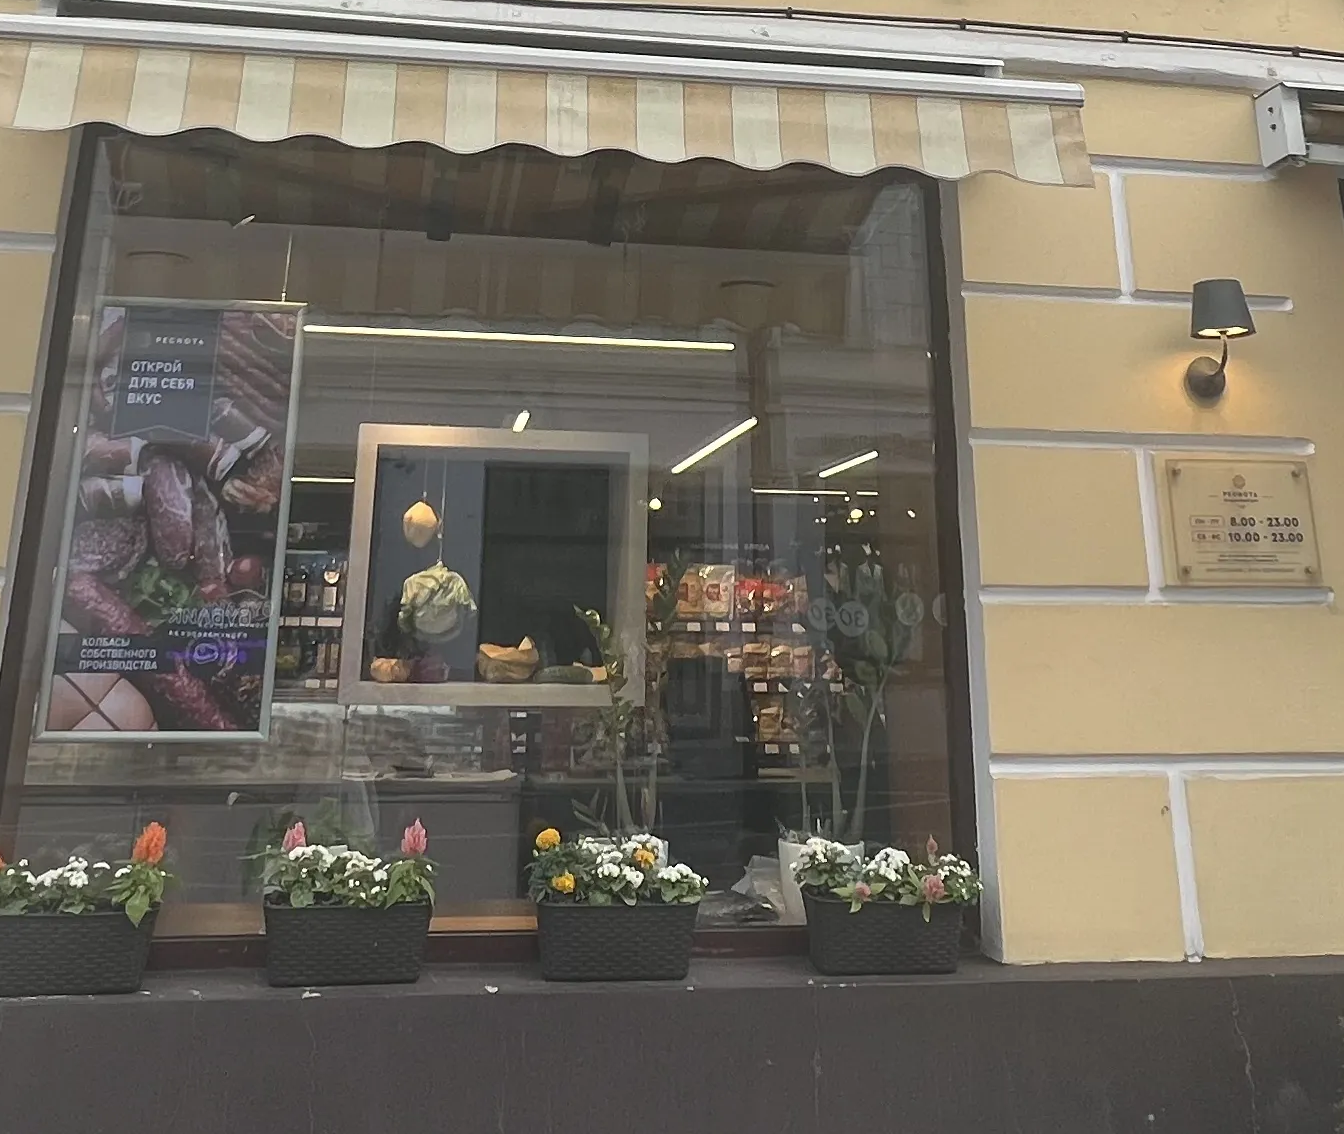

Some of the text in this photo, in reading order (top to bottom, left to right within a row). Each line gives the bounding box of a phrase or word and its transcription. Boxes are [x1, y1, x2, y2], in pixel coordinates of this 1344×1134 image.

[131, 359, 182, 373] ОТКРОЙ
[128, 376, 195, 390] ДЛЯ СЕБЯ
[126, 392, 162, 404] ВКУС
[1229, 516, 1257, 527] 8.00
[1266, 516, 1300, 528] 23.00
[1228, 532, 1261, 543] 10.00
[1271, 532, 1304, 543] 23.00
[81, 637, 131, 647] КОЛБАСЫ
[80, 648, 157, 659] СОБСТВЕННОГО
[78, 659, 158, 670] ПРОИЗВОДСТВА
